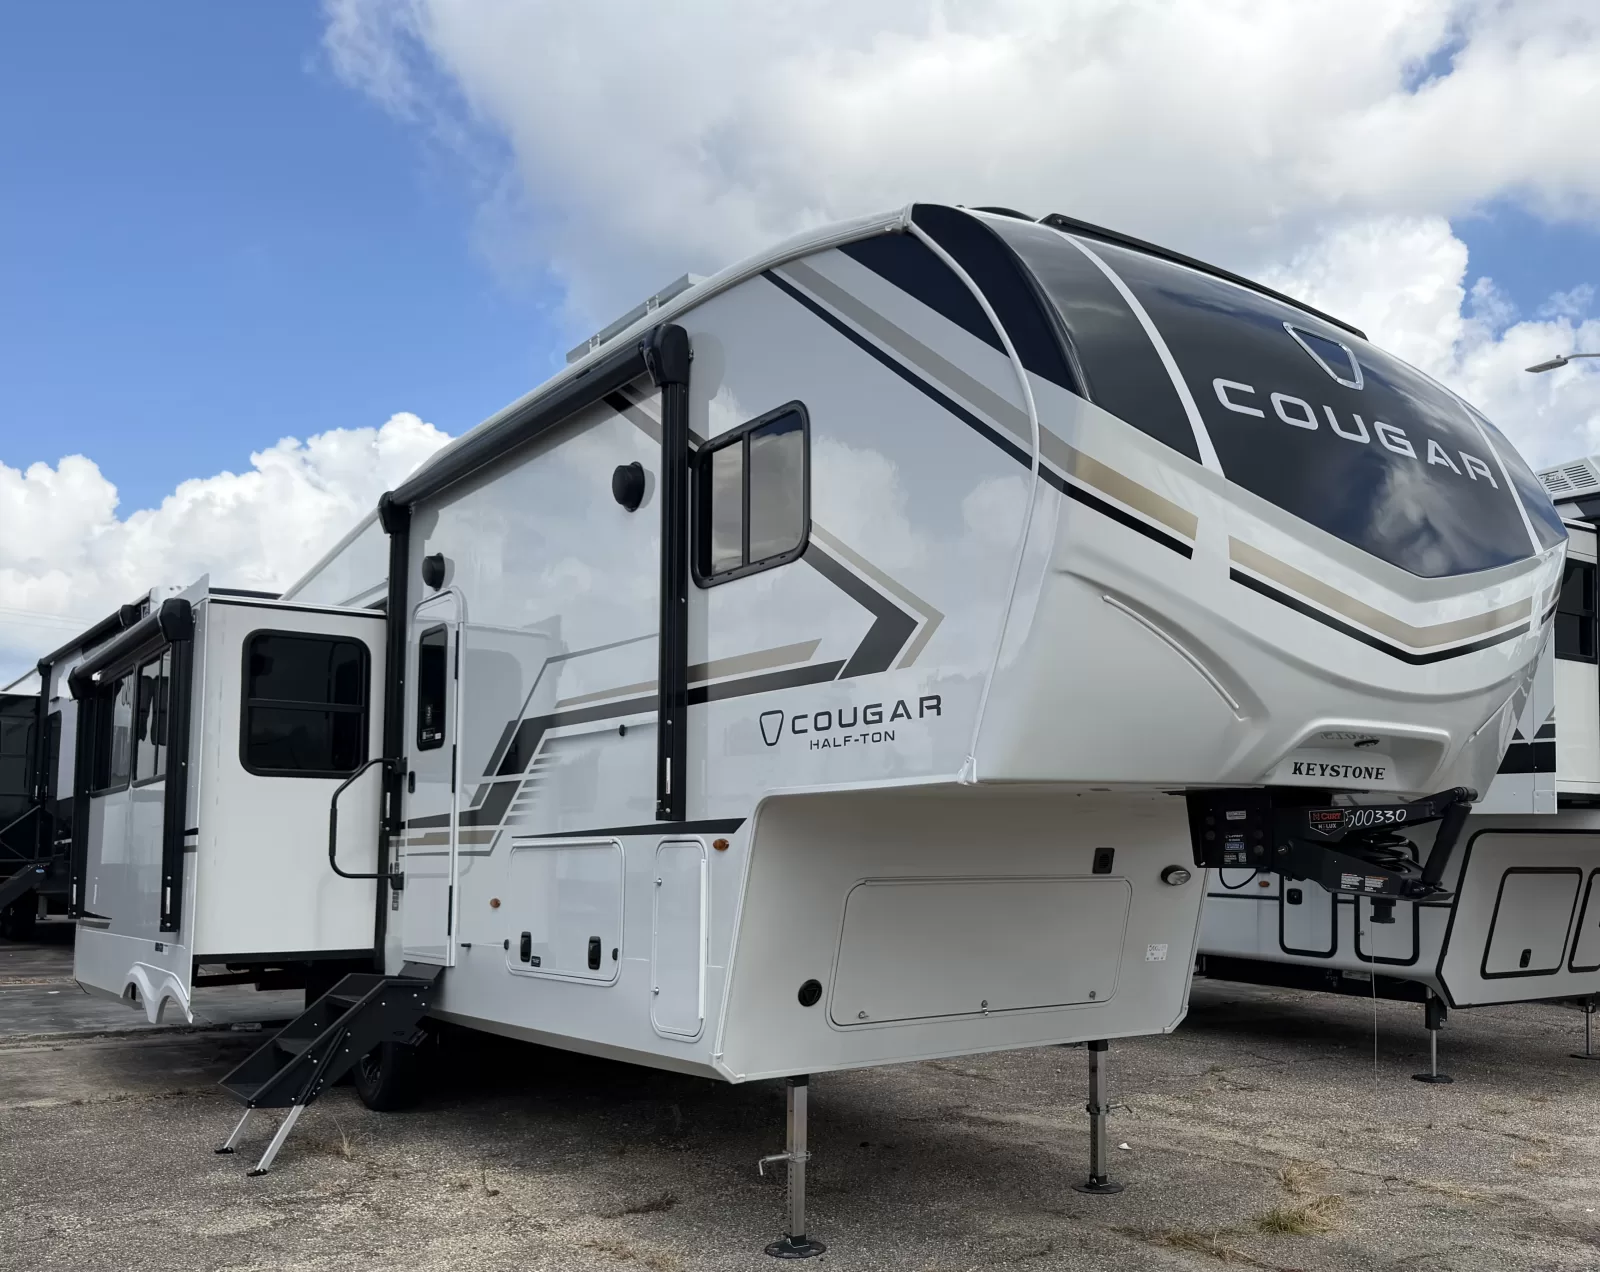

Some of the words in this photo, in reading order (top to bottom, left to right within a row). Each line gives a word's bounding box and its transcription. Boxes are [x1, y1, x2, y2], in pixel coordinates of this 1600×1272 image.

[1212, 377, 1499, 490] COUGAR
[791, 694, 942, 735] COUGAR
[810, 730, 896, 750] HALF-TON
[1291, 761, 1386, 780] KEYSTONE
[1344, 809, 1407, 828] 500330
